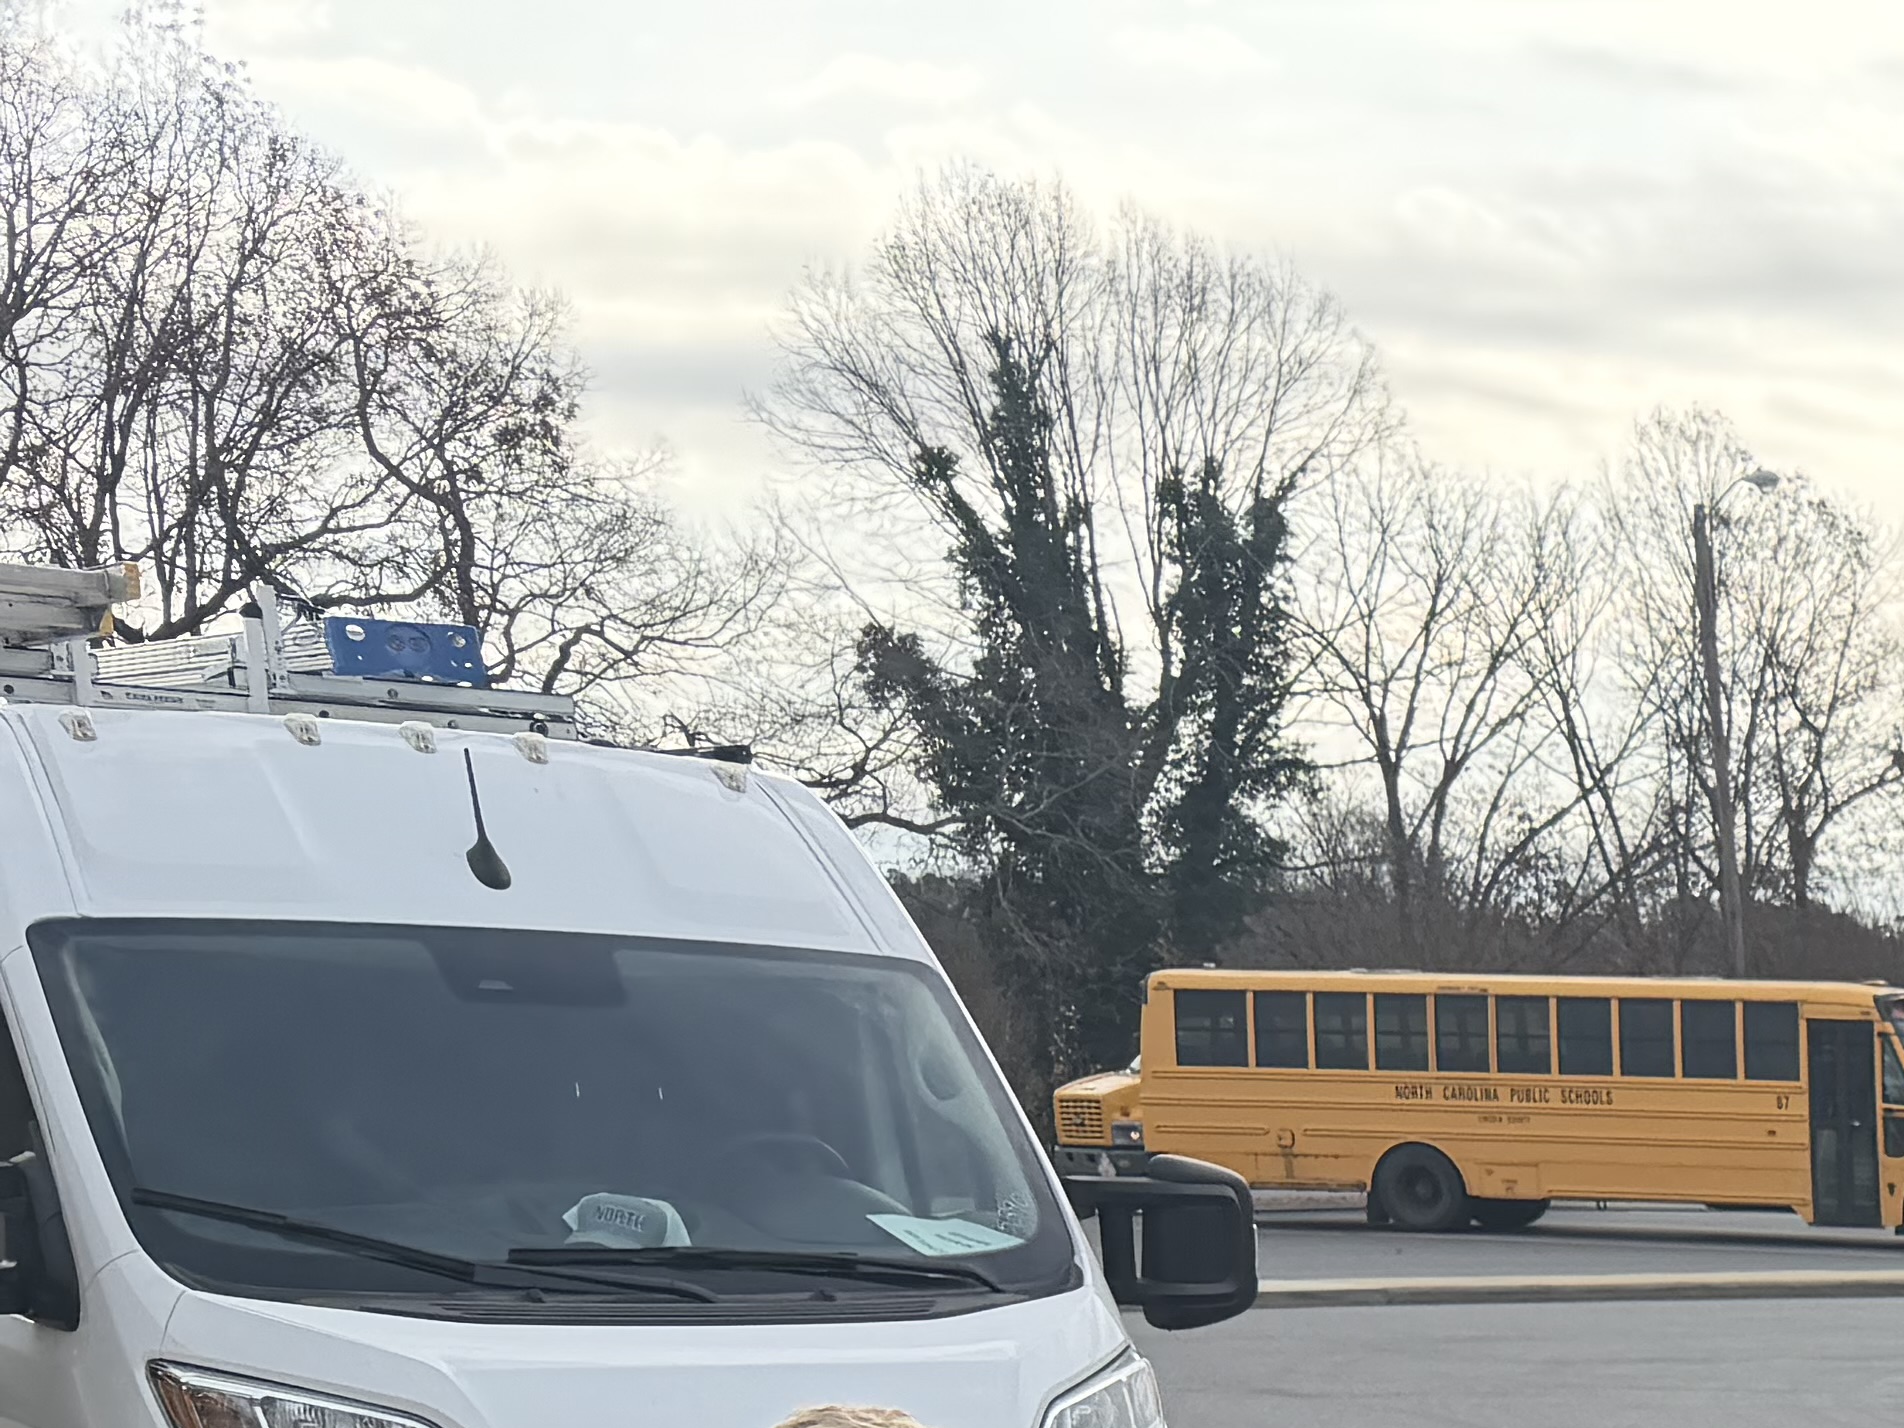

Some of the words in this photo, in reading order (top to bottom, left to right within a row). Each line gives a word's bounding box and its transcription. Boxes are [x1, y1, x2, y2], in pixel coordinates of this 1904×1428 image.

[1395, 1085, 1433, 1101] NORTH
[1443, 1086, 1500, 1102] CAROLINA
[1510, 1087, 1550, 1104] PUBLIC
[1561, 1089, 1614, 1106] SCHOOLS
